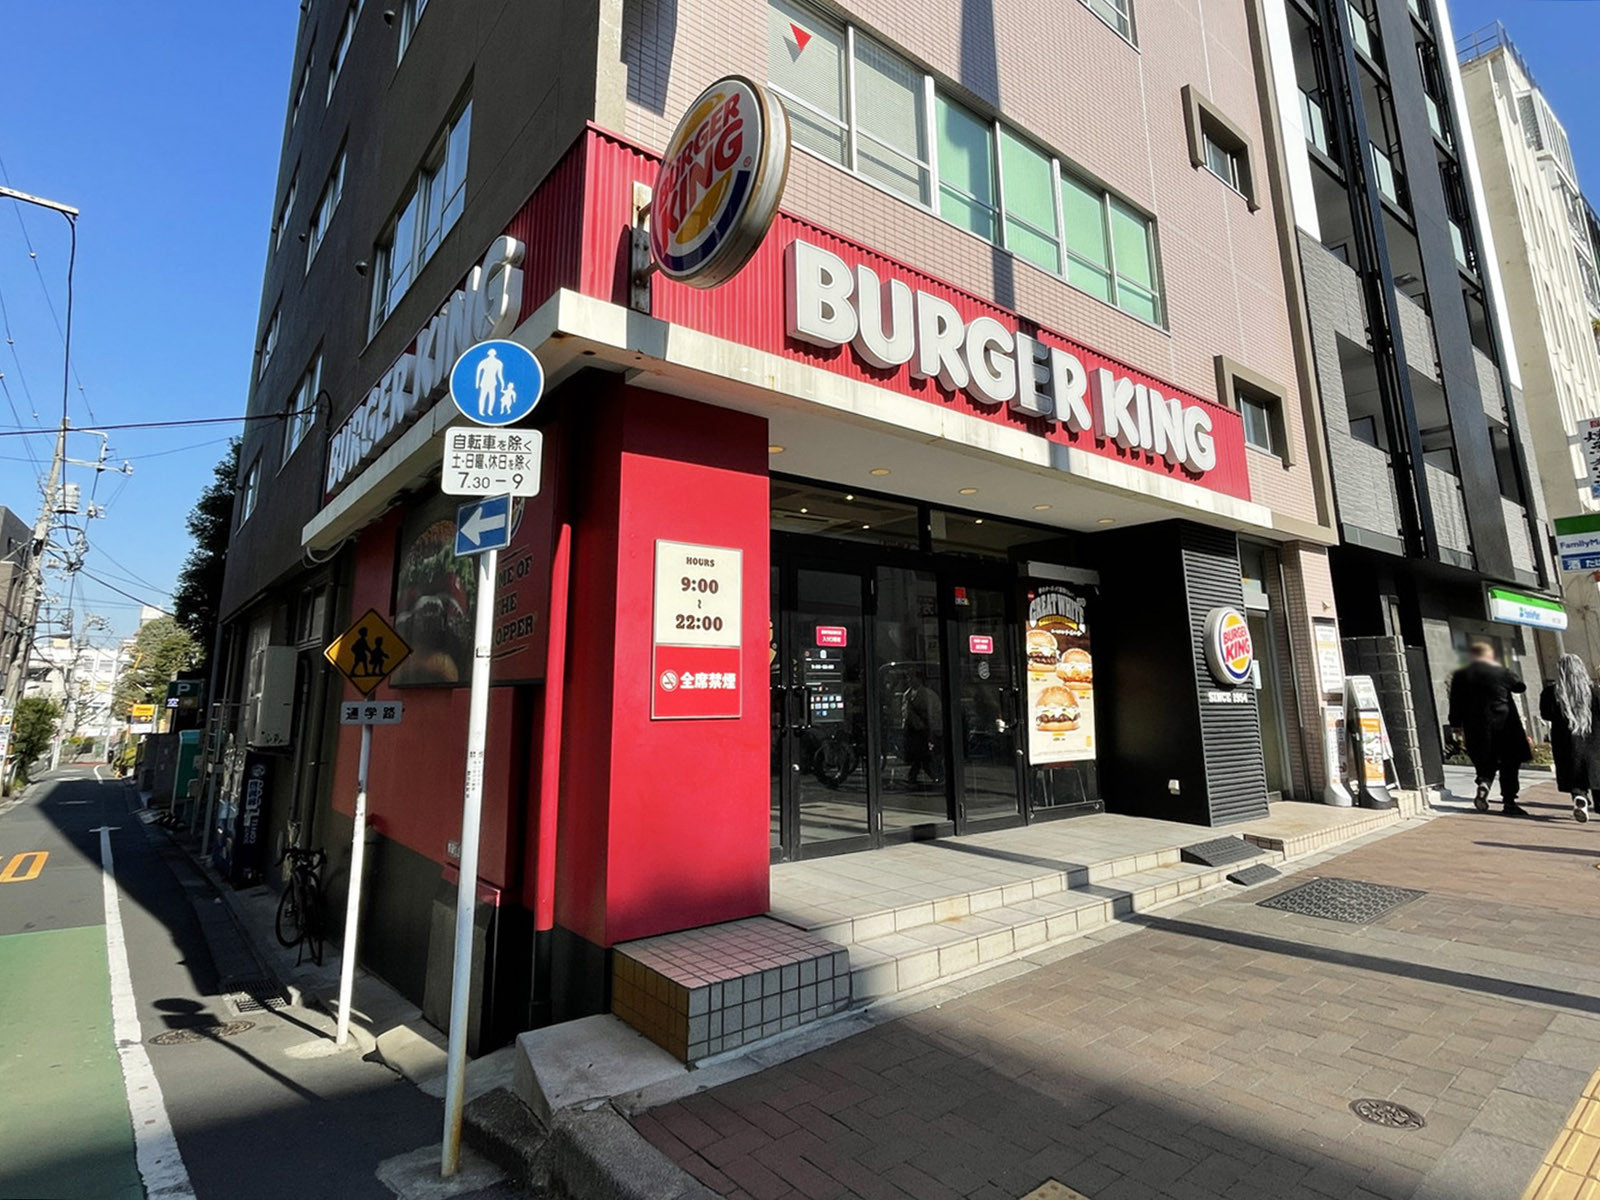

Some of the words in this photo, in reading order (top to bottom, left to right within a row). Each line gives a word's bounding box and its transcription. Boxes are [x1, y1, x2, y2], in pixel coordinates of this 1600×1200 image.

[659, 93, 741, 206] BURGER
[661, 118, 743, 257] KING
[785, 238, 1092, 433] BURGER
[1095, 367, 1216, 473] KING
[453, 434, 532, 452] 自転車を除く
[1559, 538, 1600, 549] FamilyM
[516, 556, 534, 580] OF
[686, 556, 715, 568] HOURS
[681, 576, 719, 594] 9:00
[1029, 593, 1057, 625] GREAT
[495, 614, 534, 646] OPPER
[675, 614, 723, 631] 22:00
[1223, 625, 1248, 645] BURGER
[1225, 638, 1250, 663] KING
[177, 683, 191, 696] P
[680, 671, 736, 690] 全席禁煙
[1208, 691, 1232, 703] SINCE
[1232, 692, 1249, 703] 1954
[346, 707, 396, 721] 通学路
[0, 851, 49, 883] 0
